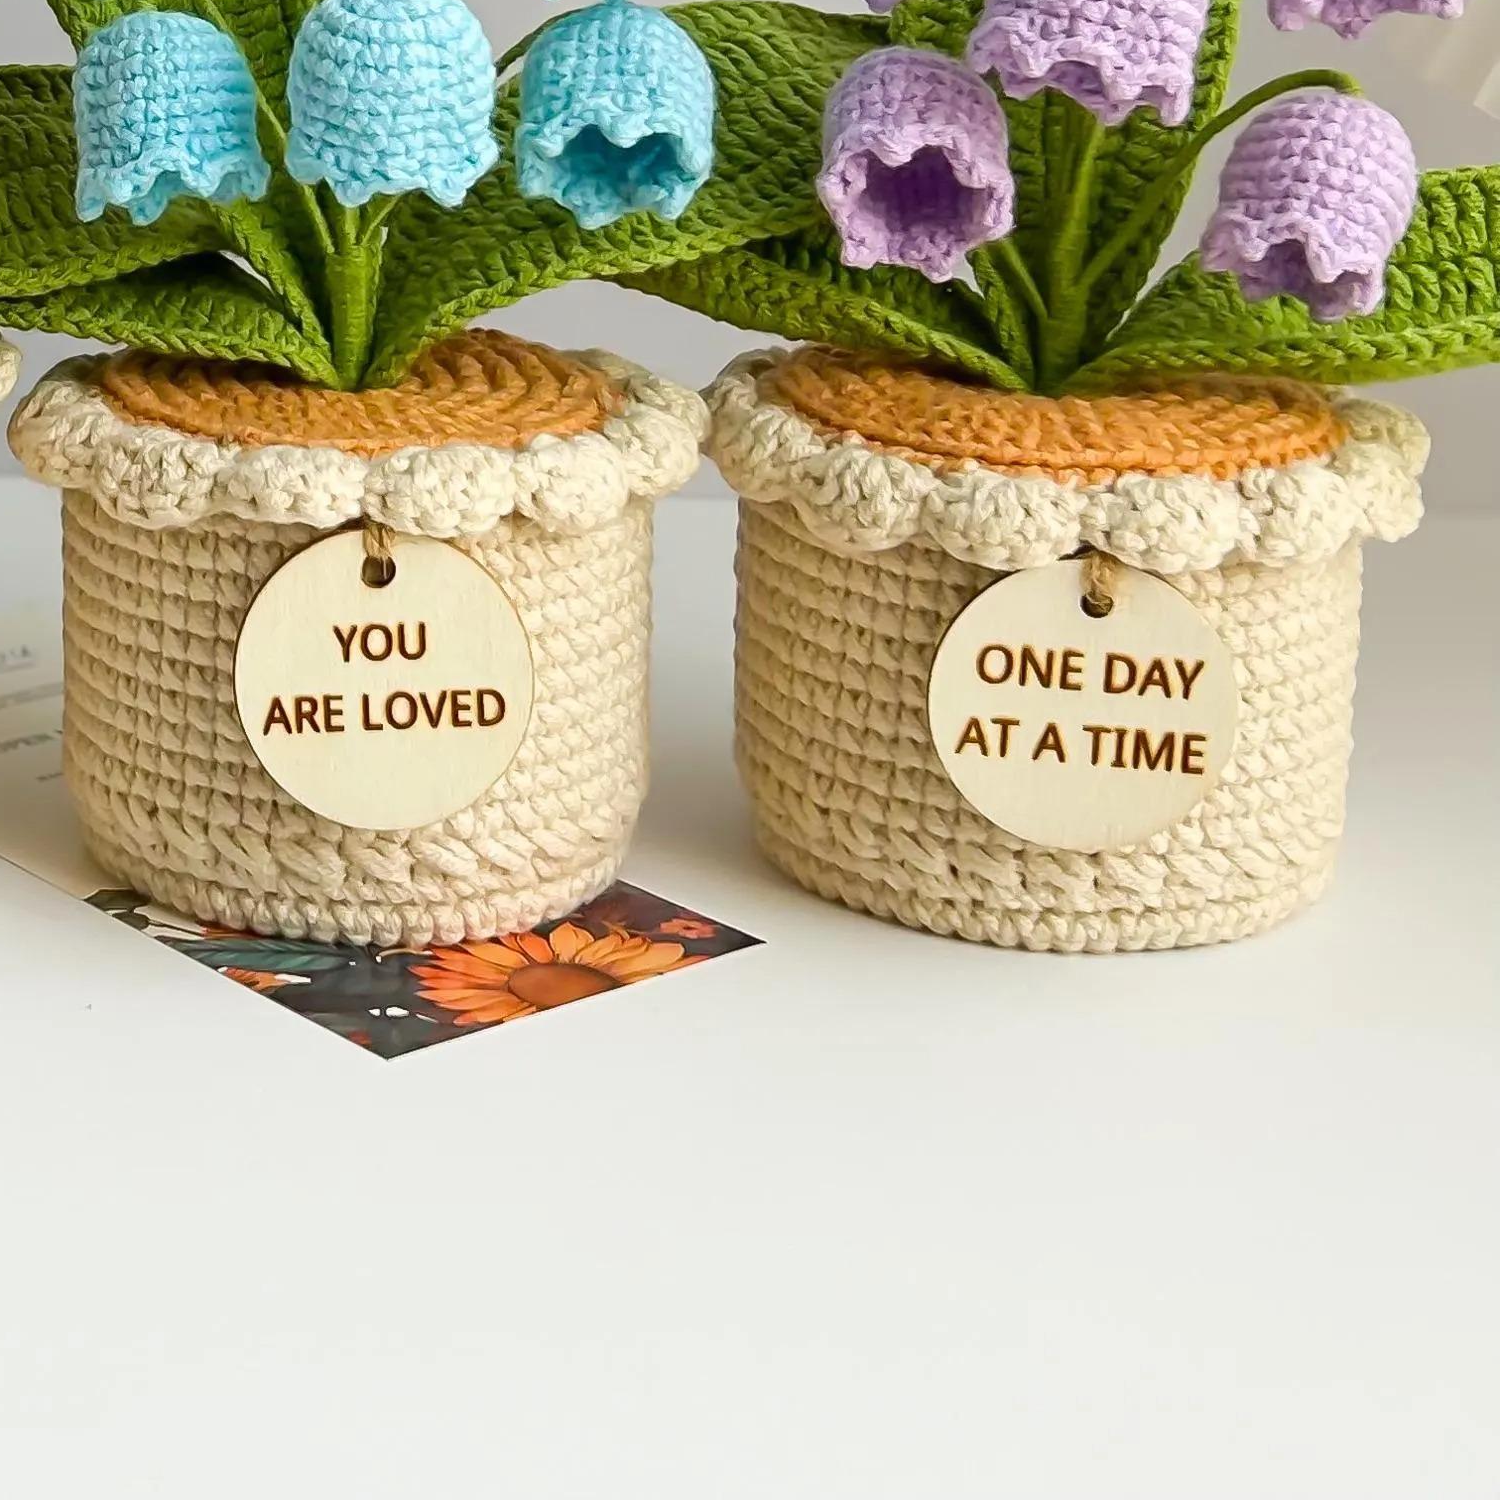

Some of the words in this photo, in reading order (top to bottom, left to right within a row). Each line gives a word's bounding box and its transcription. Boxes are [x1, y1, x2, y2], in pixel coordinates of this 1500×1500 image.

[333, 622, 427, 663] YOU
[976, 644, 1085, 692] ONE
[1103, 652, 1205, 701] DAY
[262, 694, 345, 737] ARE
[362, 689, 506, 732] LOVED
[954, 717, 1020, 758] AT
[1031, 722, 1066, 763] A
[1082, 726, 1207, 776] TIME
